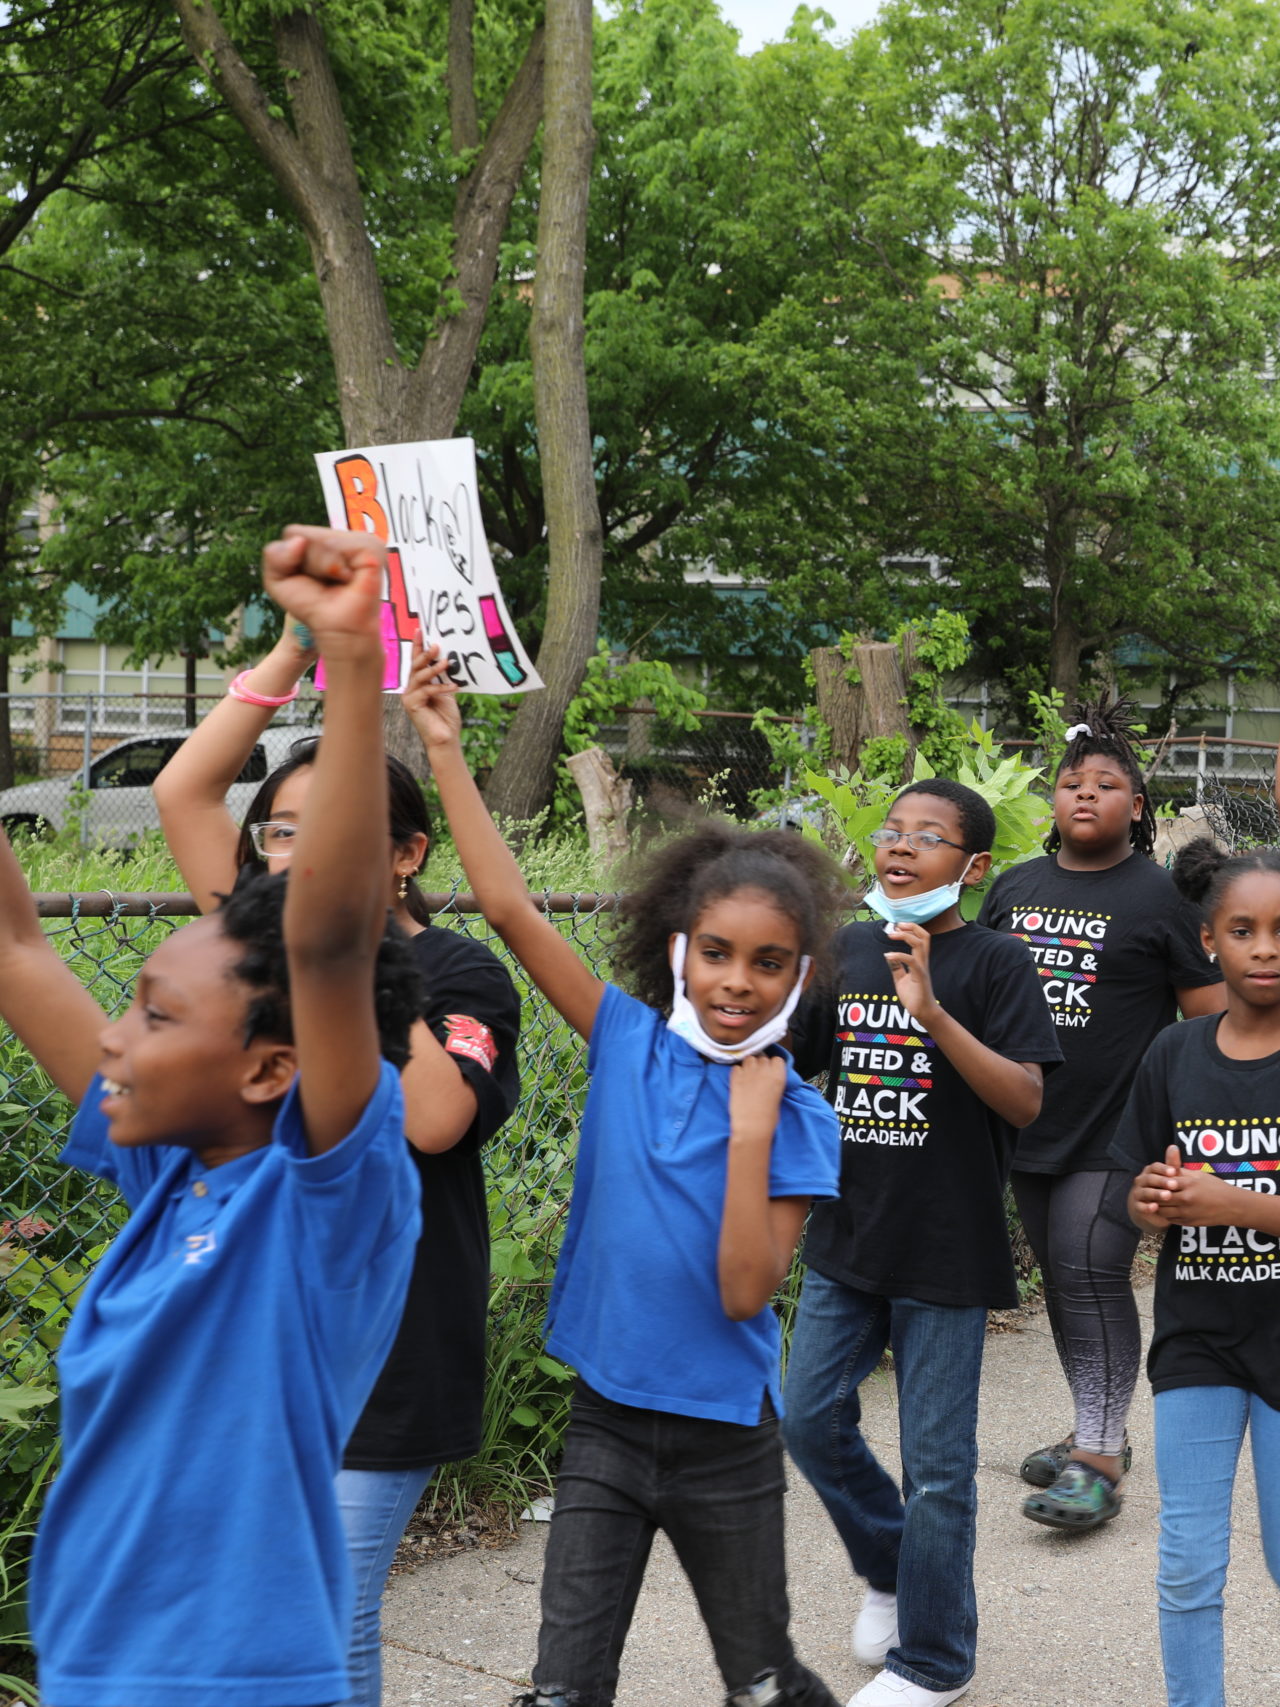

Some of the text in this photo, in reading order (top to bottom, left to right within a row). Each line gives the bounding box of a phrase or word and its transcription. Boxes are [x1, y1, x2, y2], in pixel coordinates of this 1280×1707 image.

[1011, 912, 1108, 939] YOUNG
[1080, 953, 1098, 971] &
[911, 1052, 933, 1073] &
[843, 1126, 929, 1146] ACADEMY
[1175, 1264, 1213, 1281] MLK
